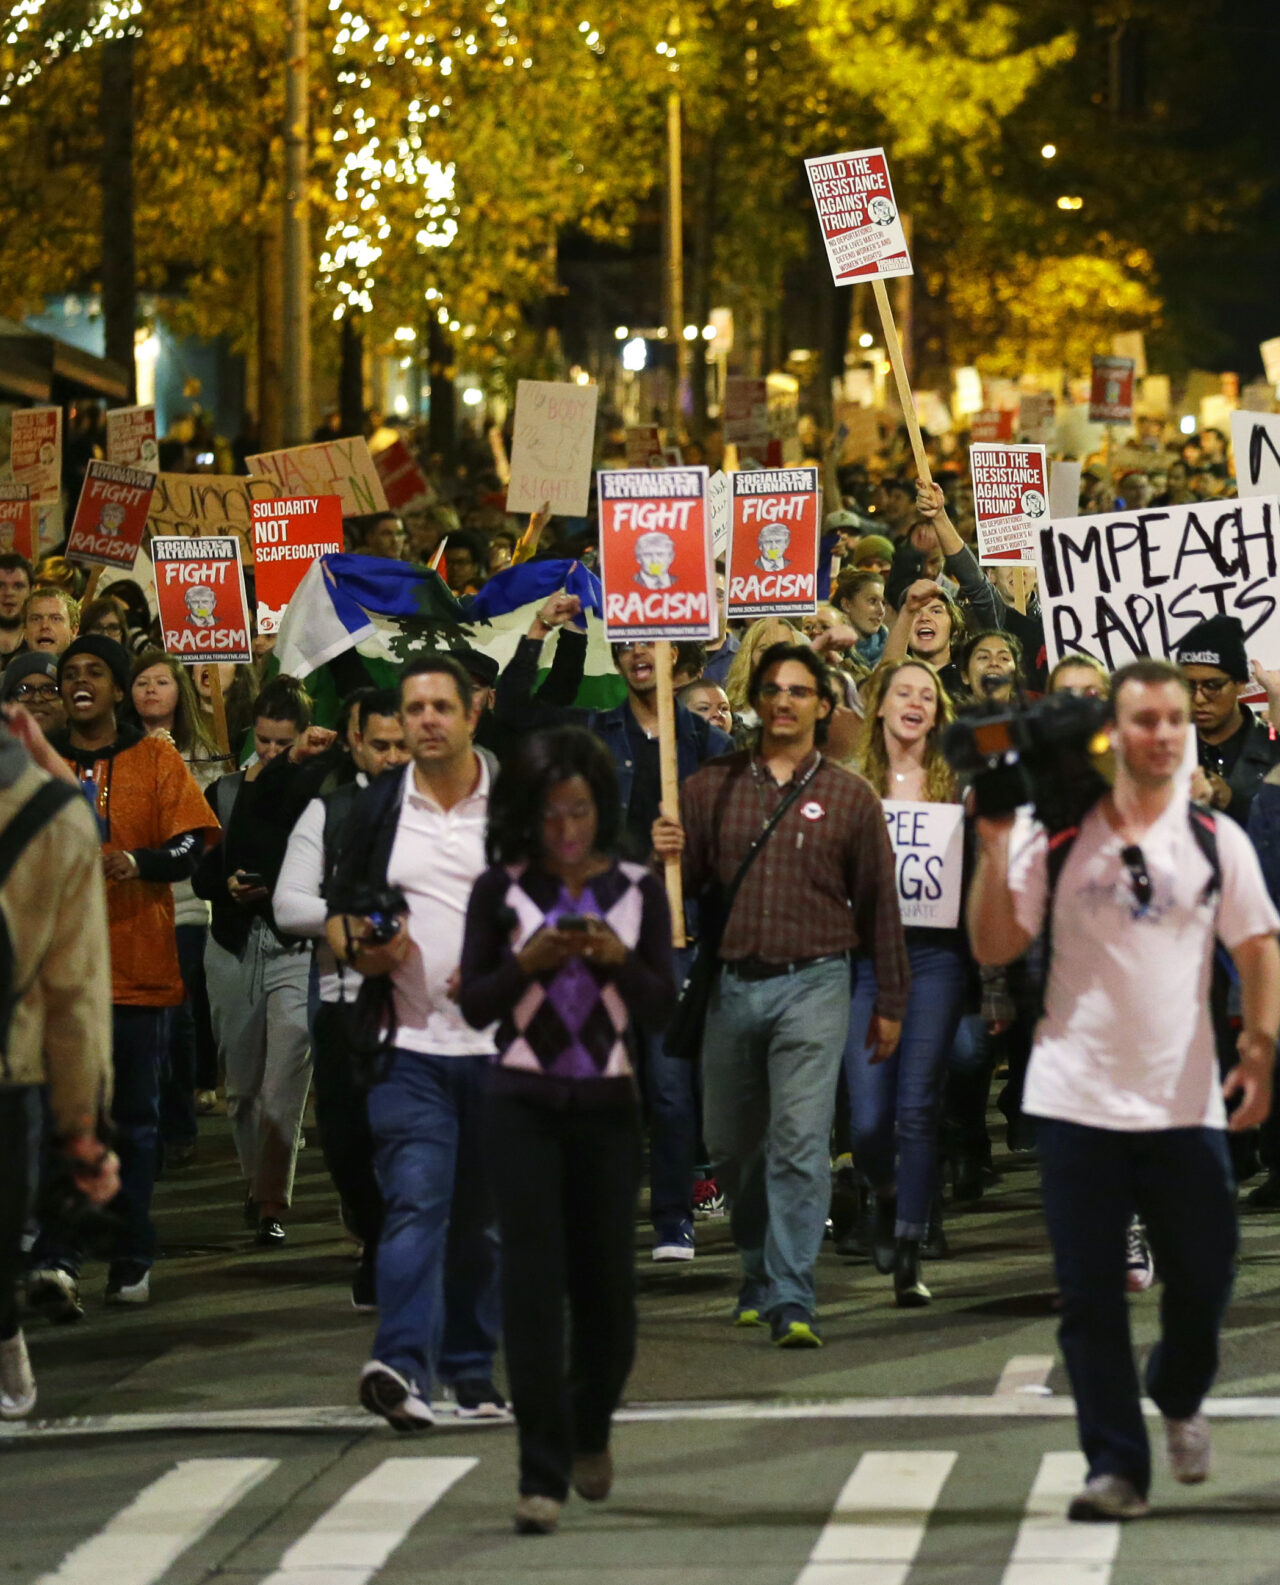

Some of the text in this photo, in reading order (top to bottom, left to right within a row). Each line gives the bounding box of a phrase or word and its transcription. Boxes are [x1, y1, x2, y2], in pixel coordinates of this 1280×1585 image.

[810, 158, 872, 182] BUILD THE
[814, 173, 886, 198] RESISTANCE
[818, 192, 868, 214] AGAINST
[822, 211, 864, 231] TRUMP
[832, 245, 848, 255] BLACK
[849, 240, 863, 250] LIVES
[974, 452, 1029, 468] BUILD THE
[604, 474, 682, 487] SOCIALIST
[736, 472, 798, 485] SOCIALIST
[975, 468, 1040, 484] RESISTANCE
[90, 482, 148, 506] FIGHT
[604, 484, 700, 498] ALTERNATIVE
[736, 480, 813, 494] ALTERNATIVE
[977, 483, 1023, 499] AGAINST
[253, 499, 318, 518] SOLIDARITY
[613, 501, 697, 532] FIGHT
[742, 495, 810, 524] FIGHT
[977, 499, 1016, 514] TRUMP
[255, 520, 289, 544] NOT
[999, 525, 1011, 535] LIVES
[72, 532, 138, 560] RACISM
[156, 540, 218, 551] SOCIALIST
[157, 548, 234, 559] ALTERNATIVE
[256, 542, 340, 562] SCAPEGOATING
[1040, 503, 1277, 598] IMPEACH
[165, 561, 231, 586] FIGHT
[730, 573, 814, 601] RACISM
[607, 592, 708, 623] RACISM
[1053, 577, 1276, 672] RAPISTS
[166, 628, 246, 651] RACISM
